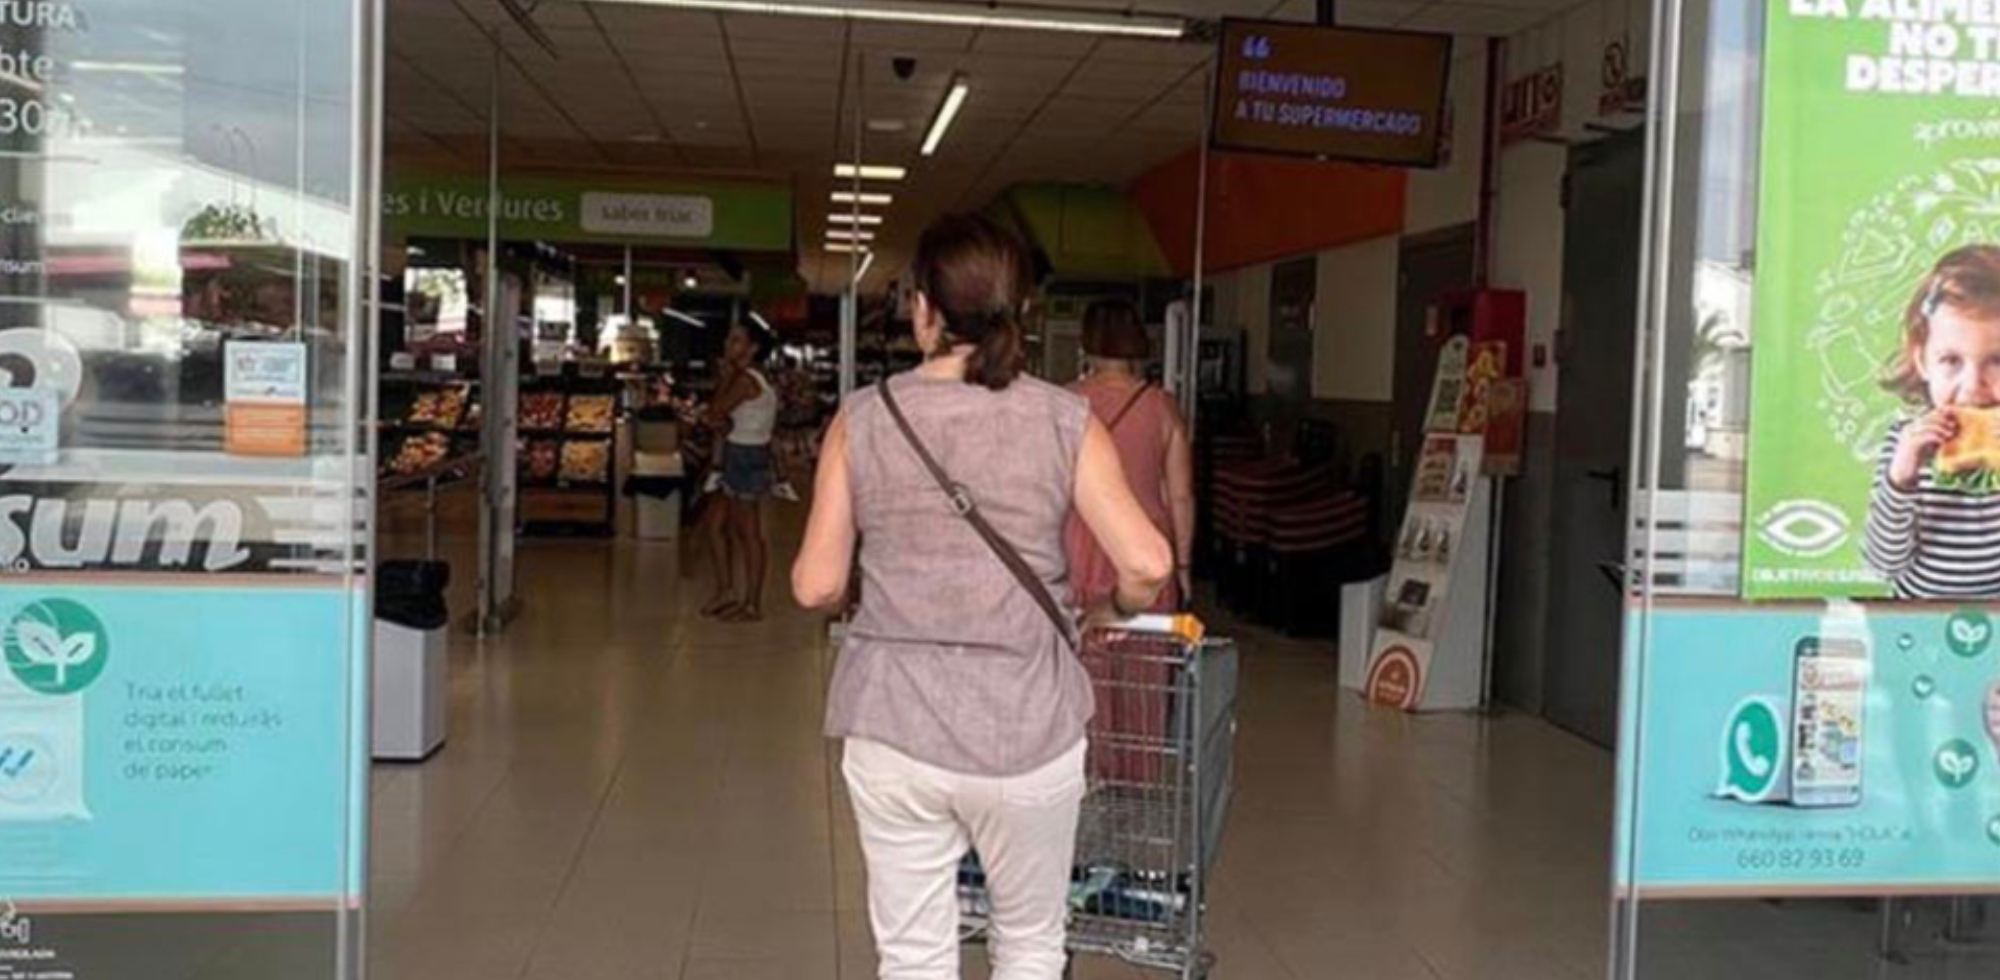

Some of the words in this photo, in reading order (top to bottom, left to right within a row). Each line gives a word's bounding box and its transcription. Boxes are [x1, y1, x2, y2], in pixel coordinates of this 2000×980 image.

[1889, 22, 1959, 57] NO
[1239, 70, 1346, 98] BIENVENIDO
[1235, 99, 1248, 119] A
[1253, 100, 1275, 121] TU
[1277, 102, 1421, 135] SUPERMERCADO
[147, 738, 228, 753] consum
[122, 762, 149, 780] de
[1736, 848, 1776, 870] 660
[1778, 848, 1806, 870] 82
[1809, 848, 1835, 870] 93
[1837, 848, 1866, 870] 69
